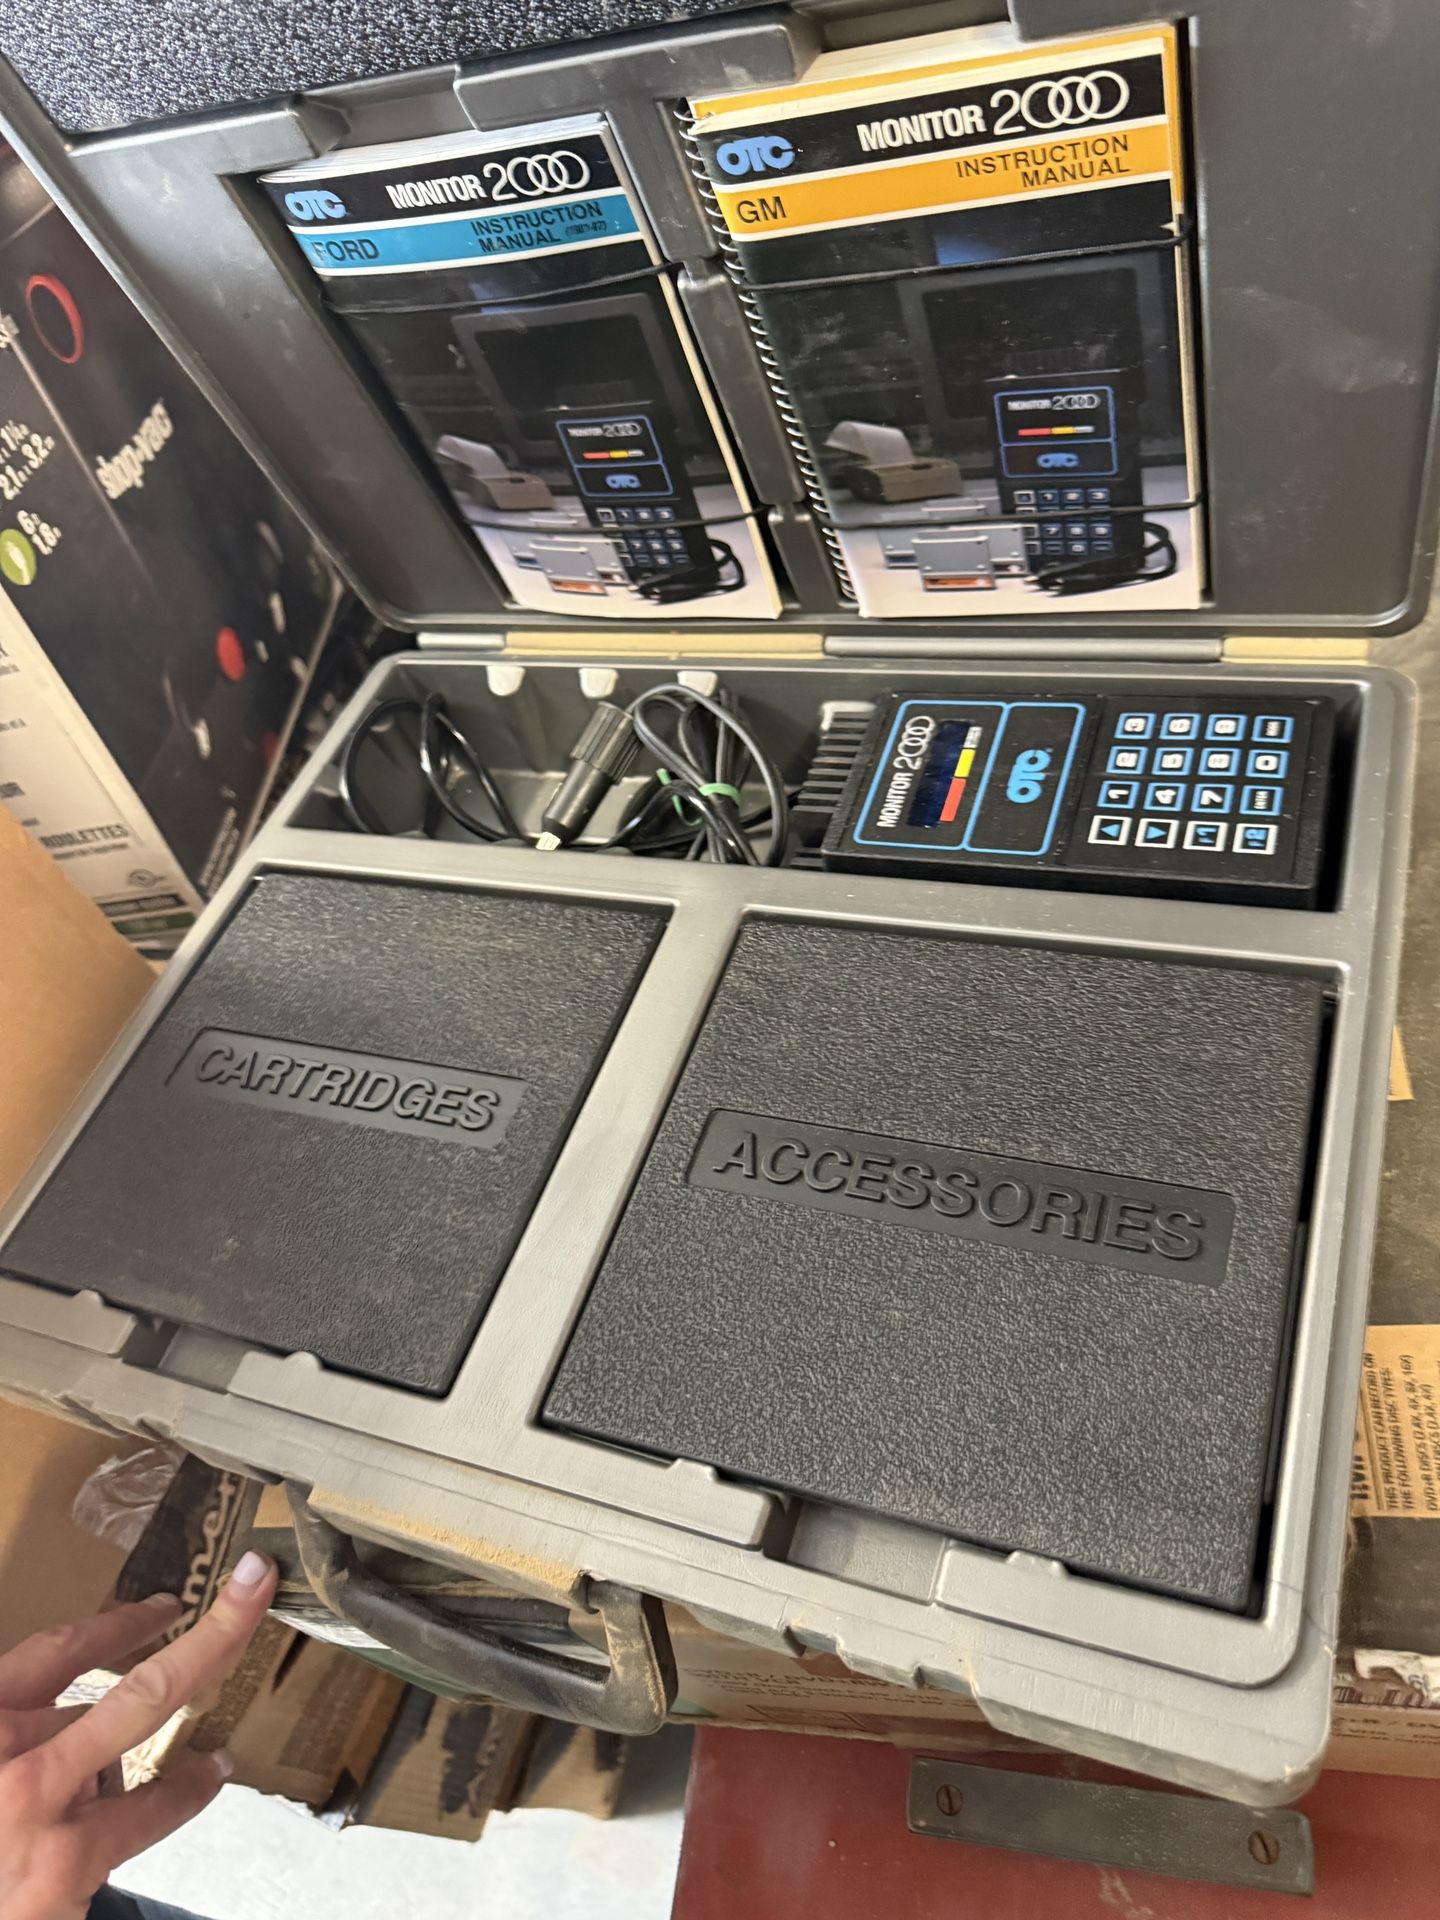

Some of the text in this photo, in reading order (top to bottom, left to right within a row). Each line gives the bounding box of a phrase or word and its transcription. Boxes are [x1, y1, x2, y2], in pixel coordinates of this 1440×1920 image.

[857, 70, 1130, 152] MONITOR 2000
[716, 137, 795, 176] OTC
[955, 135, 1129, 178] INSTRUCTION
[385, 150, 591, 210] MONITOR 2000
[1022, 158, 1130, 188] MANUAL
[284, 190, 346, 221] OTC
[471, 200, 603, 236] INSTRUCTION
[737, 195, 787, 224] GM
[310, 237, 380, 263] FORD
[479, 230, 561, 253] MANUAL
[1051, 393, 1100, 411] 2000
[1036, 452, 1080, 469] OTC
[605, 474, 641, 489] OTC
[876, 715, 936, 828] MONITOR 2000
[1115, 752, 1139, 768] 2
[1161, 753, 1184, 769] 5
[1255, 755, 1278, 771] 0
[1006, 749, 1051, 804] OTC
[1107, 789, 1130, 800] 1
[1155, 789, 1176, 804] 4
[1200, 789, 1223, 806] 7
[196, 1044, 500, 1131] CARTRIDGES
[712, 1131, 1205, 1261] ACCESSORIES
[1385, 1400, 1398, 1423] DISC
[1363, 1353, 1398, 1509] THIS PRODUCT CAN RECORD ON
[1390, 1425, 1409, 1487] FOLLOWING
[1415, 1442, 1429, 1471] DISCS
[1400, 1490, 1415, 1510] THE
